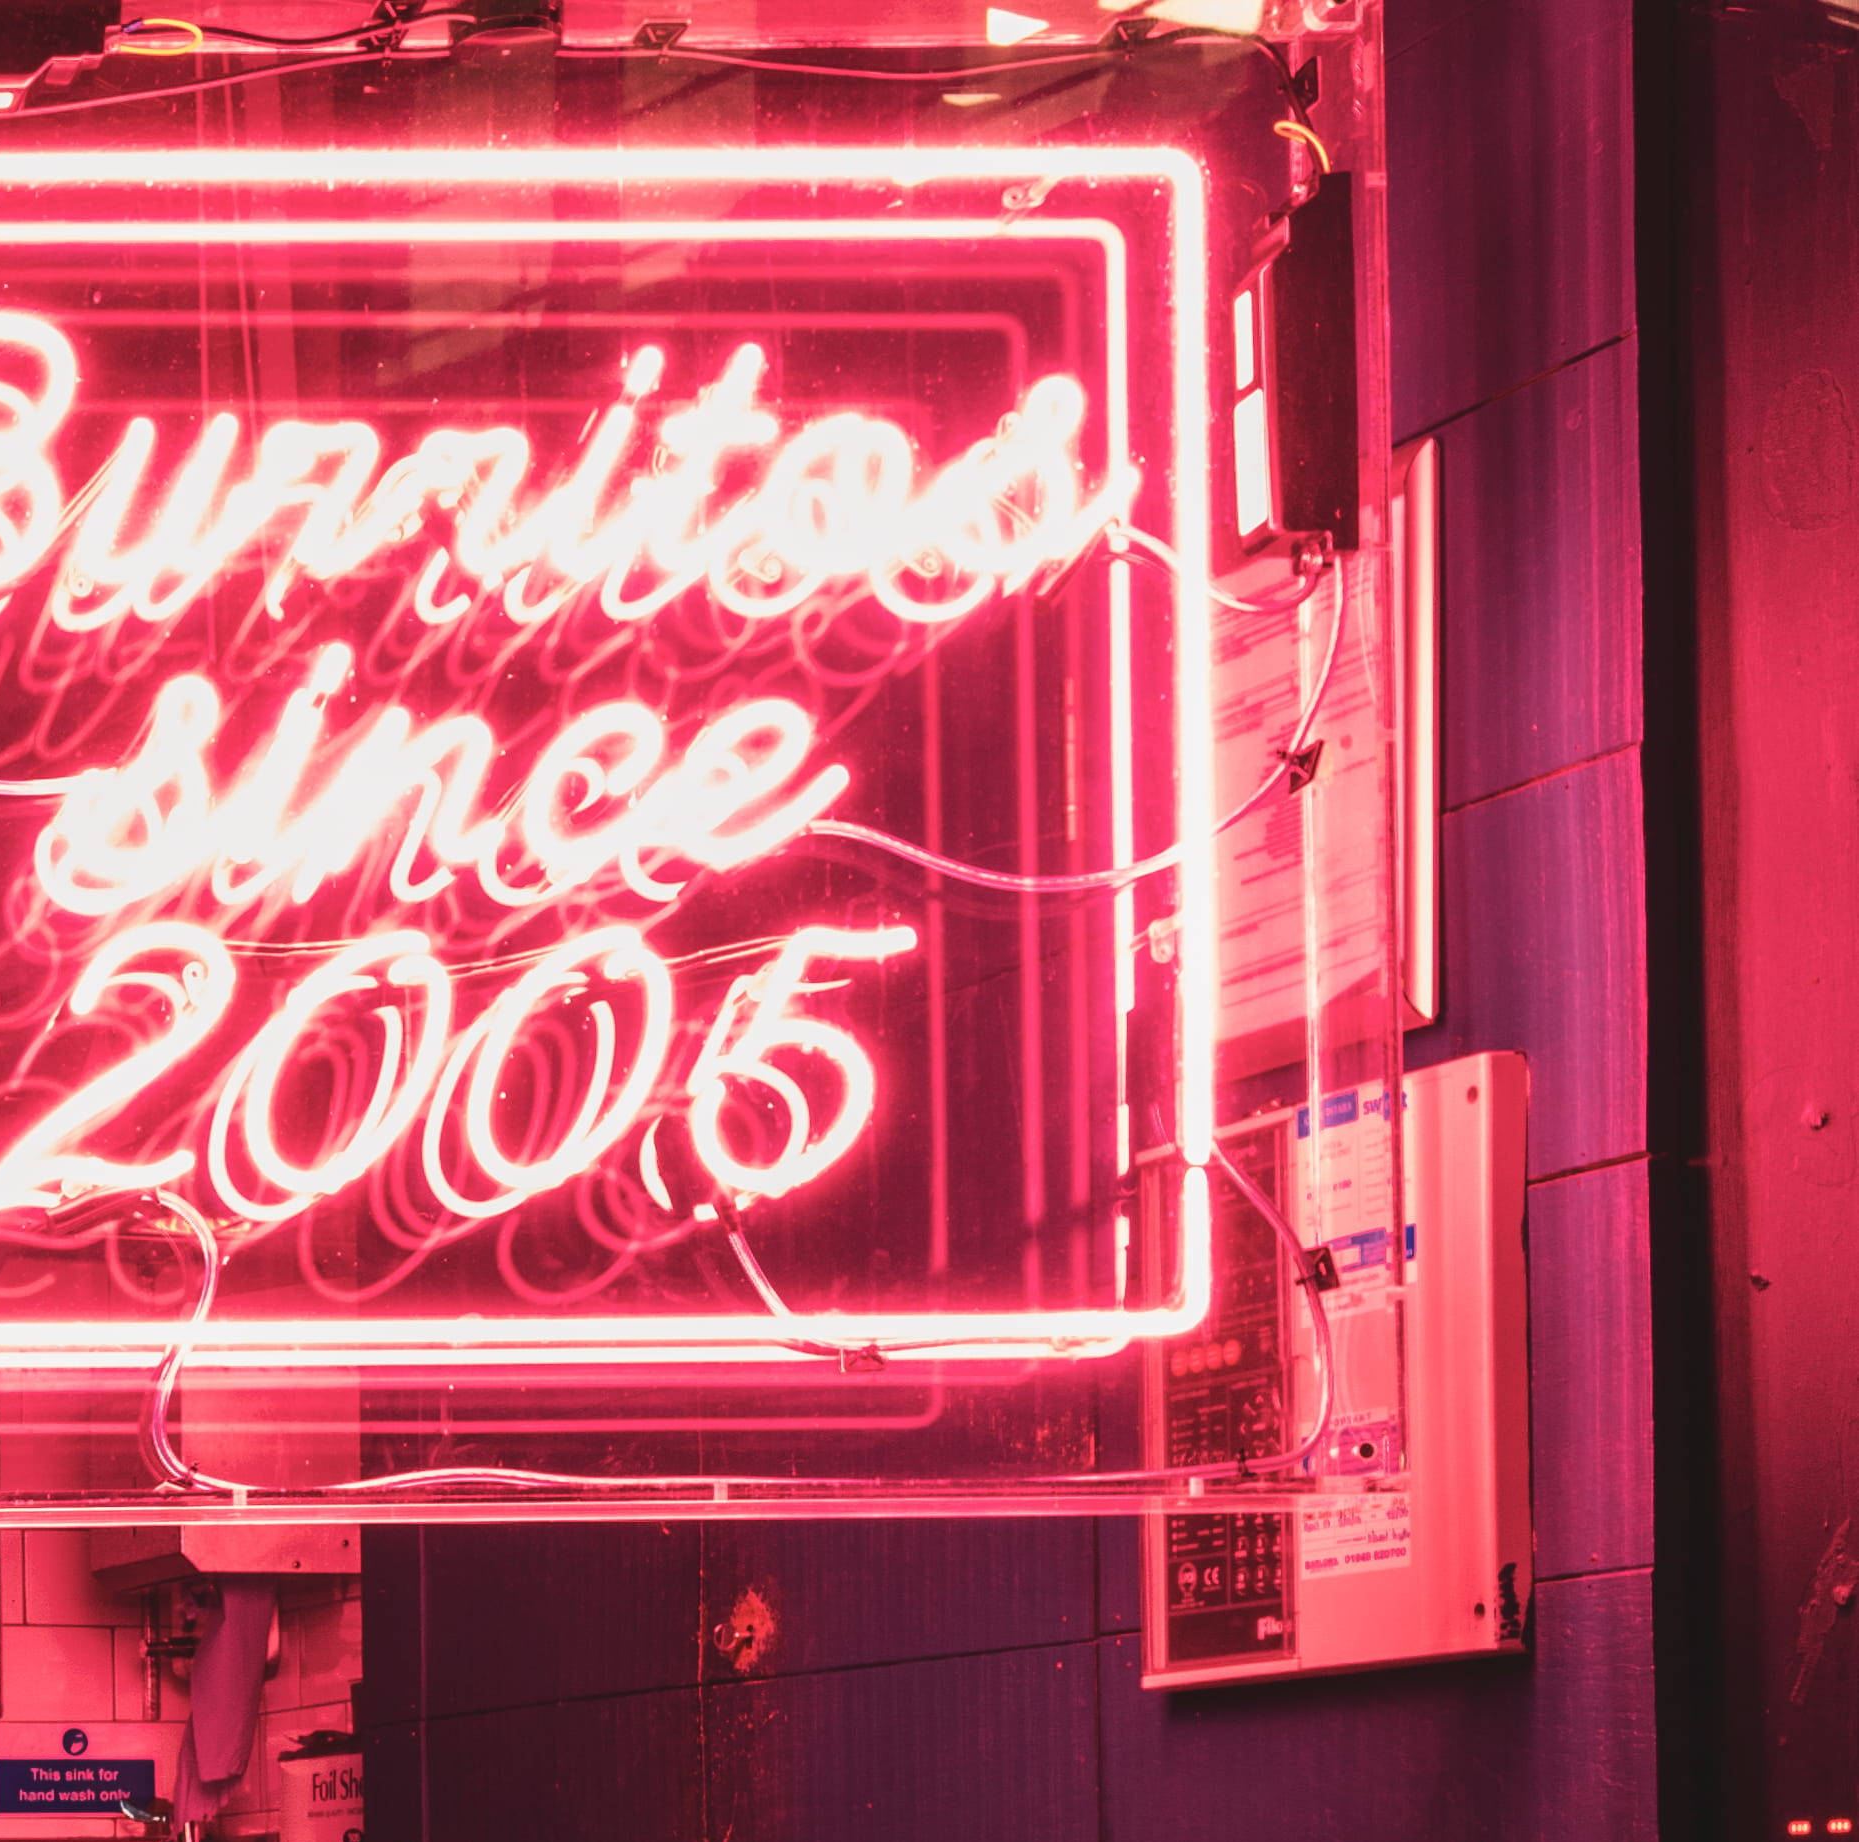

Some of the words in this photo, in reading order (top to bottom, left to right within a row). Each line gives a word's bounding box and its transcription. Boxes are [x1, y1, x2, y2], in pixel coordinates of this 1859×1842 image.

[36, 642, 847, 914] since
[30, 1767, 61, 1782] This
[65, 1767, 95, 1782] sink
[99, 1767, 119, 1782] for
[312, 1769, 337, 1802] Foil
[19, 1788, 55, 1802] hand
[58, 1788, 96, 1802] wash
[99, 1788, 131, 1803] only
